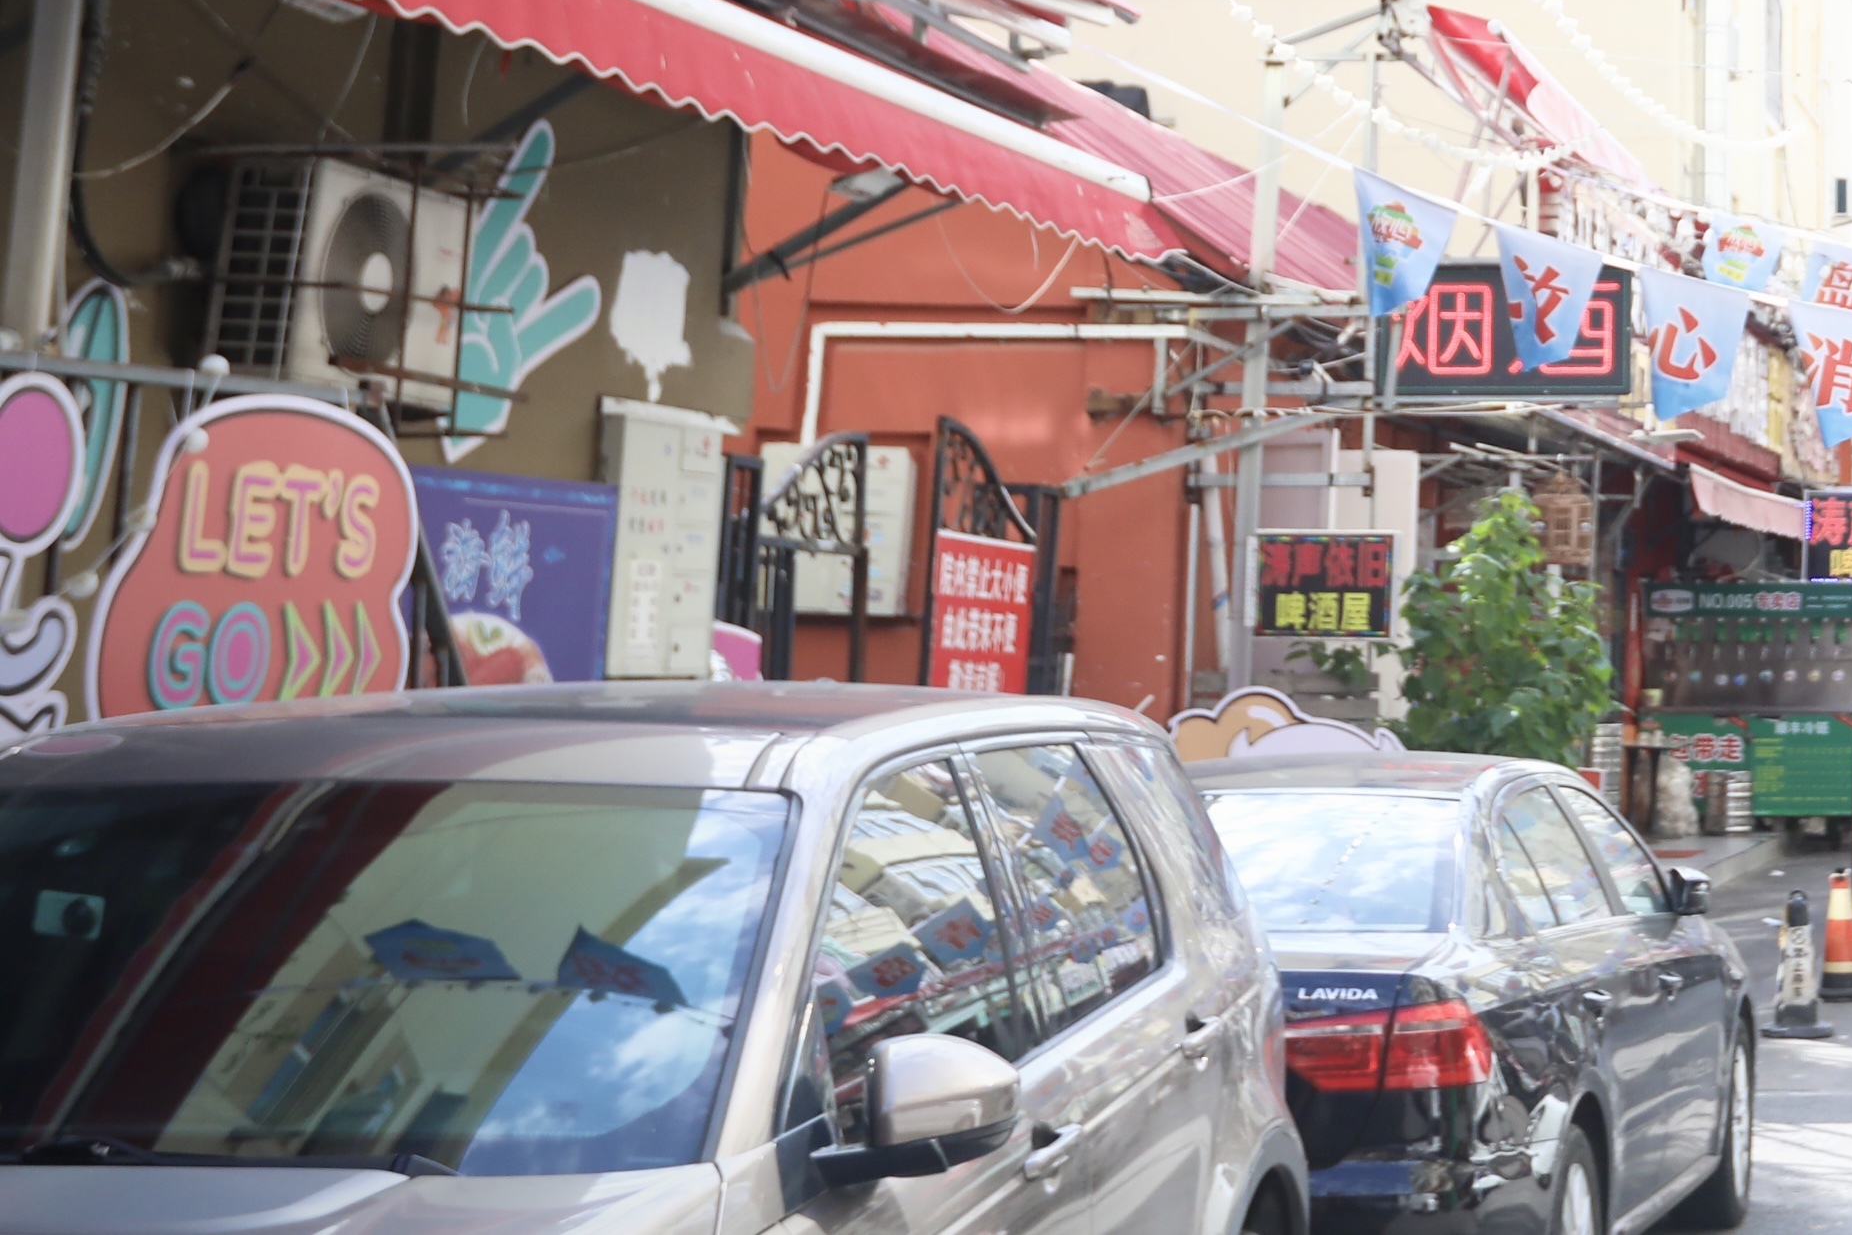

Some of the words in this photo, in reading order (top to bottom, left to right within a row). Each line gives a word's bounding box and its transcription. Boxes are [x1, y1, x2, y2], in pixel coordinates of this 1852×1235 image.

[1647, 306, 1717, 381] 心
[179, 459, 380, 580] LET'S
[149, 601, 271, 711] GO
[1298, 987, 1379, 1001] LAVIDA
